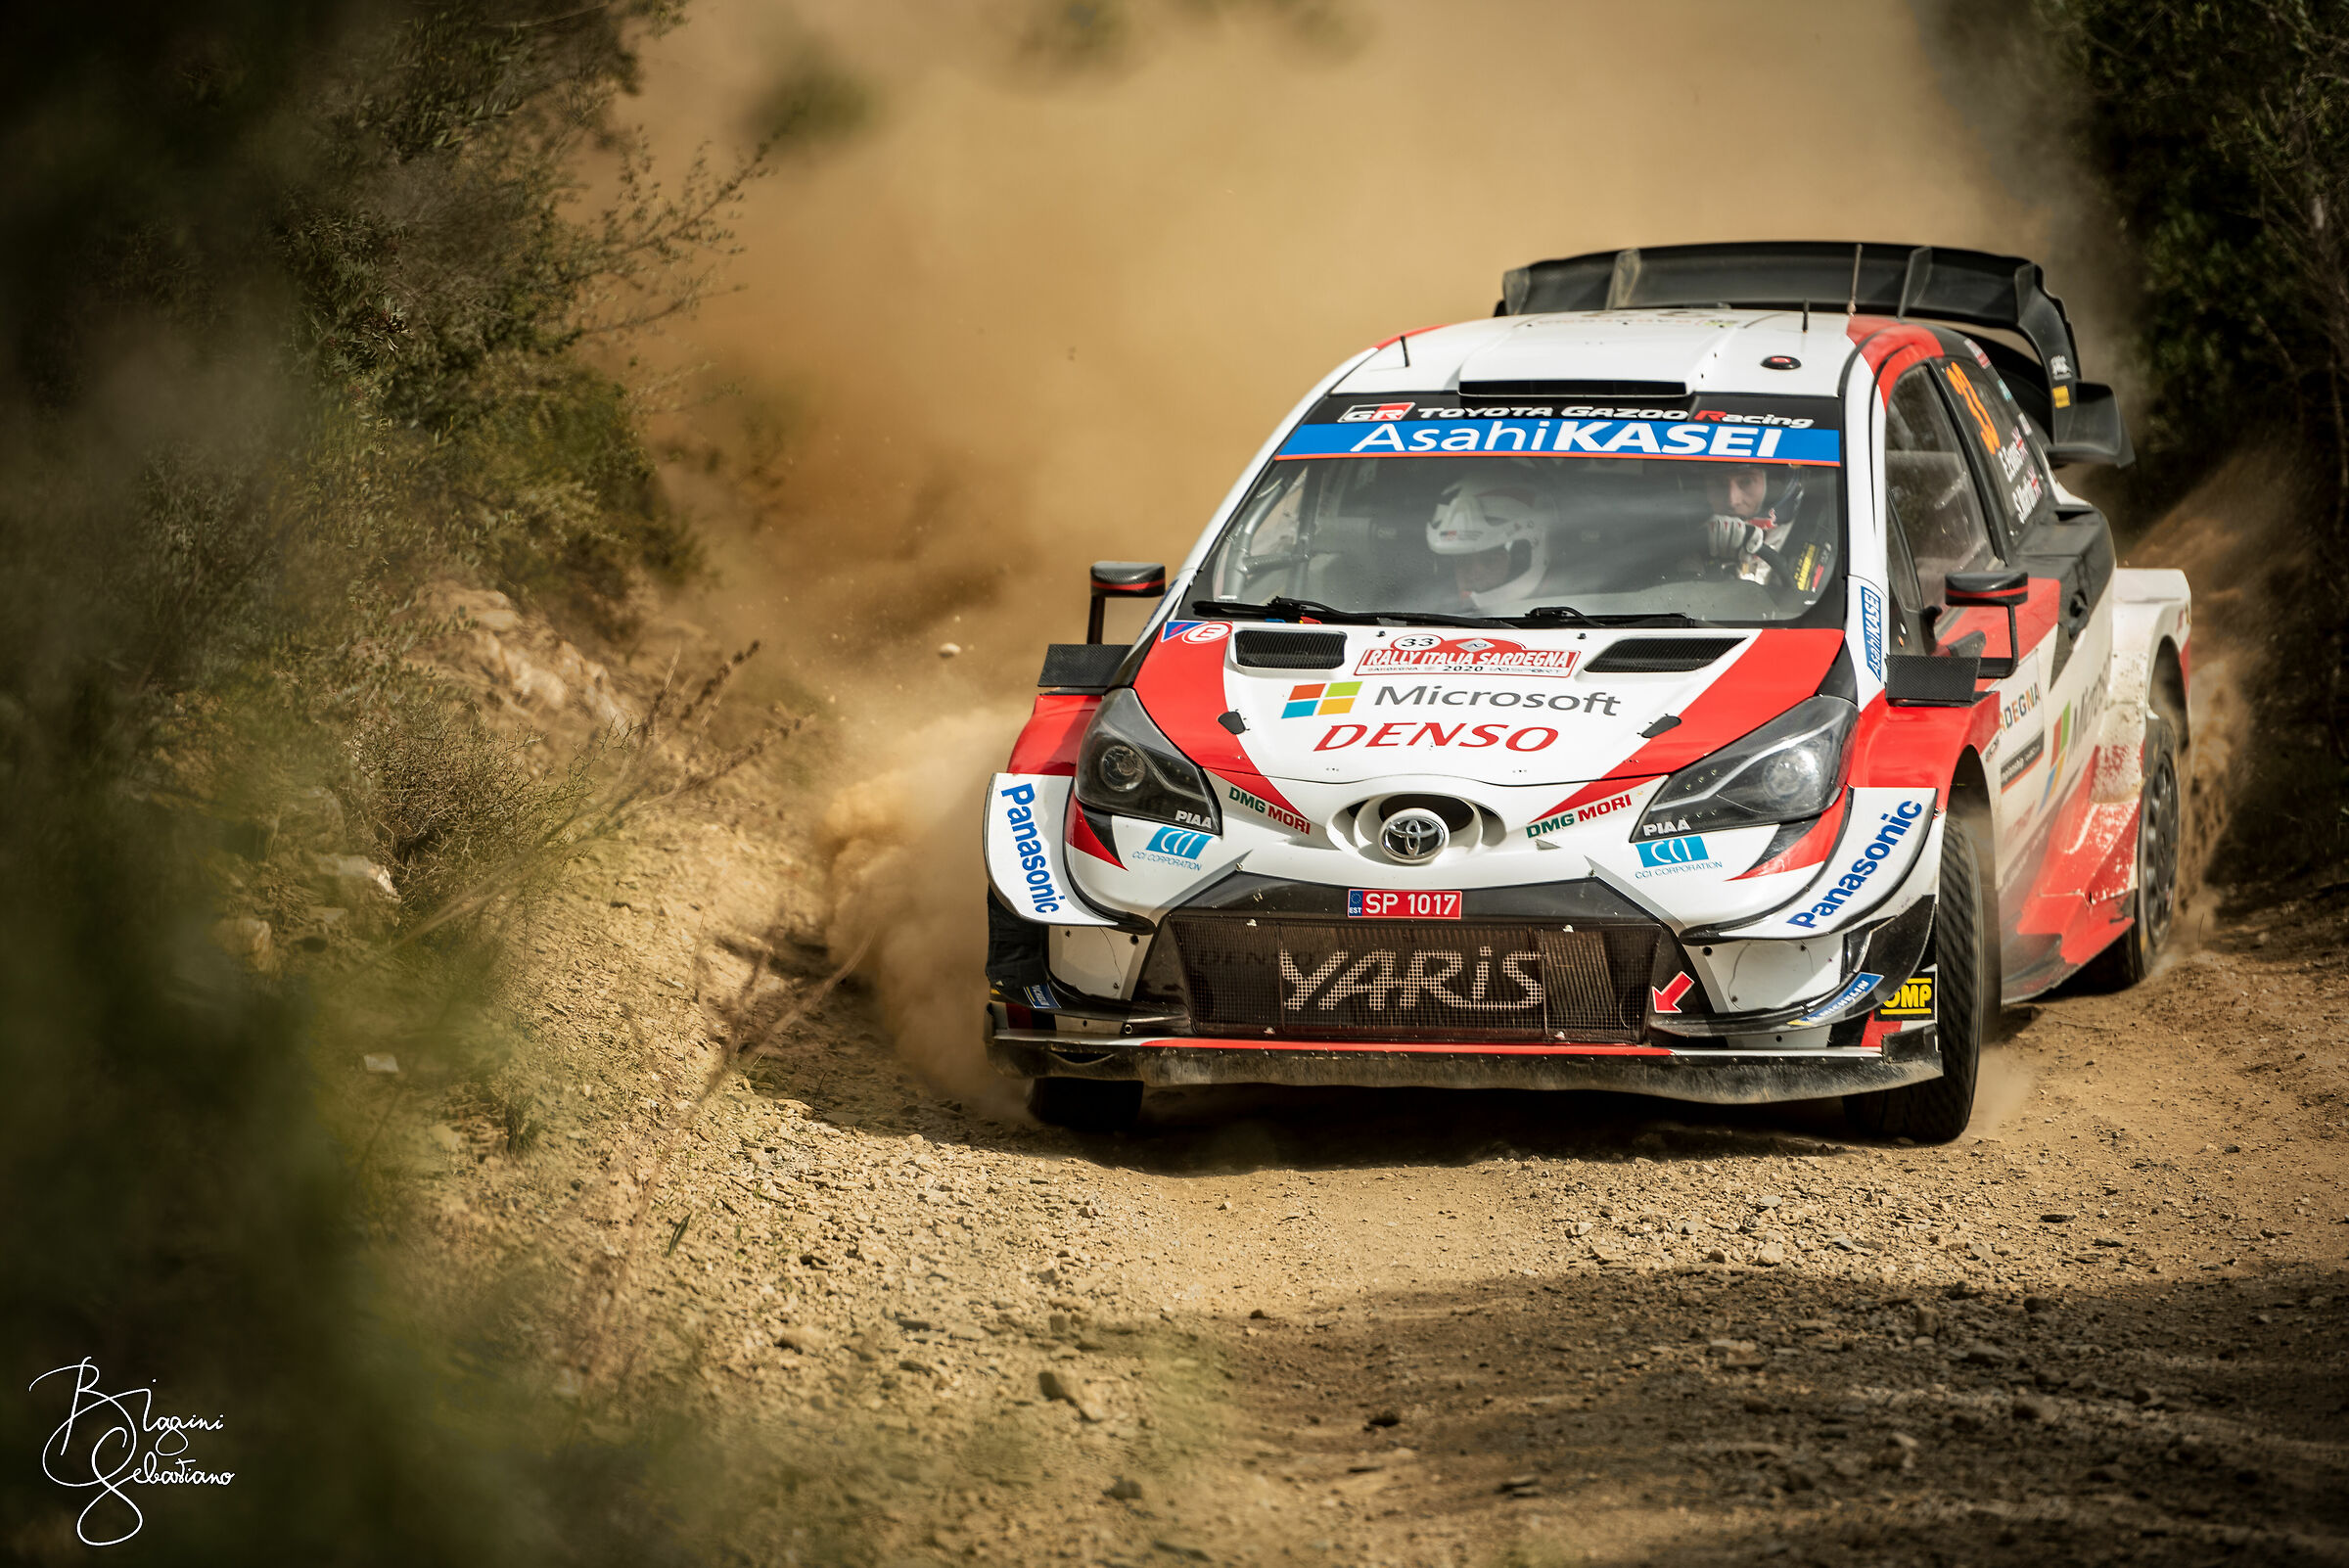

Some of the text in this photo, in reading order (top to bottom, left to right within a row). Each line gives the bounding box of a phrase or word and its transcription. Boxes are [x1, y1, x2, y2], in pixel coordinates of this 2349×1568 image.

[1418, 407, 1553, 419] TOYOTA
[1560, 406, 1689, 420] GAZOO
[1693, 409, 1815, 429] Racing
[1401, 637, 1435, 648] 33
[1366, 649, 1570, 668] RALLY ITALIA SARDEGNA
[1374, 685, 1621, 716] Microsoft
[1313, 722, 1559, 752] DENSO
[1174, 809, 1212, 829] PIAA
[1228, 786, 1312, 836] DMG MORI
[1526, 794, 1633, 839] DMG MORI
[1642, 819, 1691, 837] PIAA
[1000, 782, 1066, 914] Panasonic
[1160, 830, 1200, 856] CCI
[1650, 838, 1692, 863] CCI
[1132, 851, 1202, 871] CCI CORPORATION
[1635, 861, 1724, 879] CCI CORPORATION
[1786, 801, 1922, 928] Panasonic
[1365, 893, 1399, 914] SP
[1407, 894, 1457, 915] 1017
